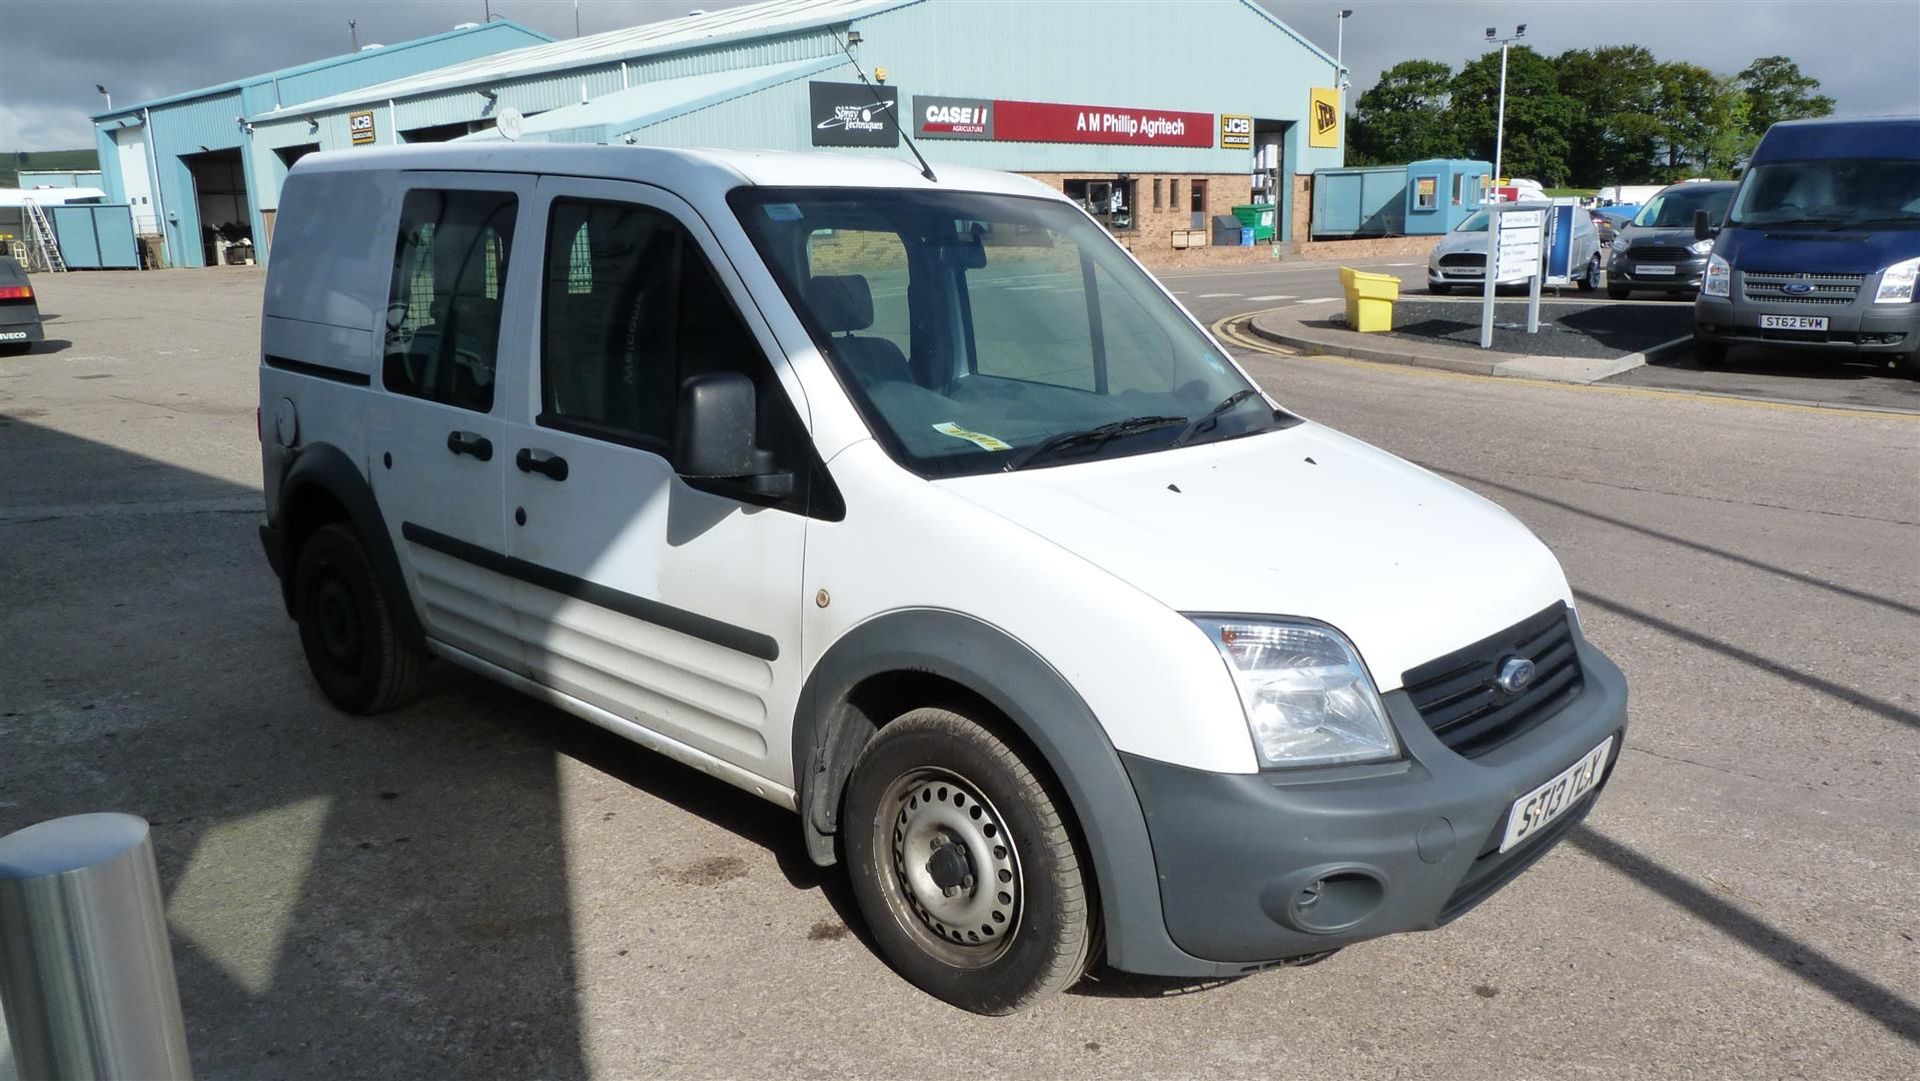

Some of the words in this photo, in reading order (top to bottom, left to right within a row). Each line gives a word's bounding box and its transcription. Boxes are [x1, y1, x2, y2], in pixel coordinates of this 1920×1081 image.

[834, 105, 859, 121] Spray
[926, 105, 972, 123] CASE
[351, 115, 371, 130] JCB
[843, 117, 883, 132] Techniques
[952, 125, 984, 133] AGRICULTURE
[1076, 112, 1087, 131] A
[1088, 113, 1100, 132] M
[1103, 114, 1138, 137] Phillip
[1139, 116, 1185, 138] Agritech
[1224, 118, 1250, 133] JCB
[1766, 317, 1797, 327] ST62
[1799, 318, 1822, 328] EVM
[1518, 778, 1567, 838] ST13
[1567, 750, 1603, 804] TLX
